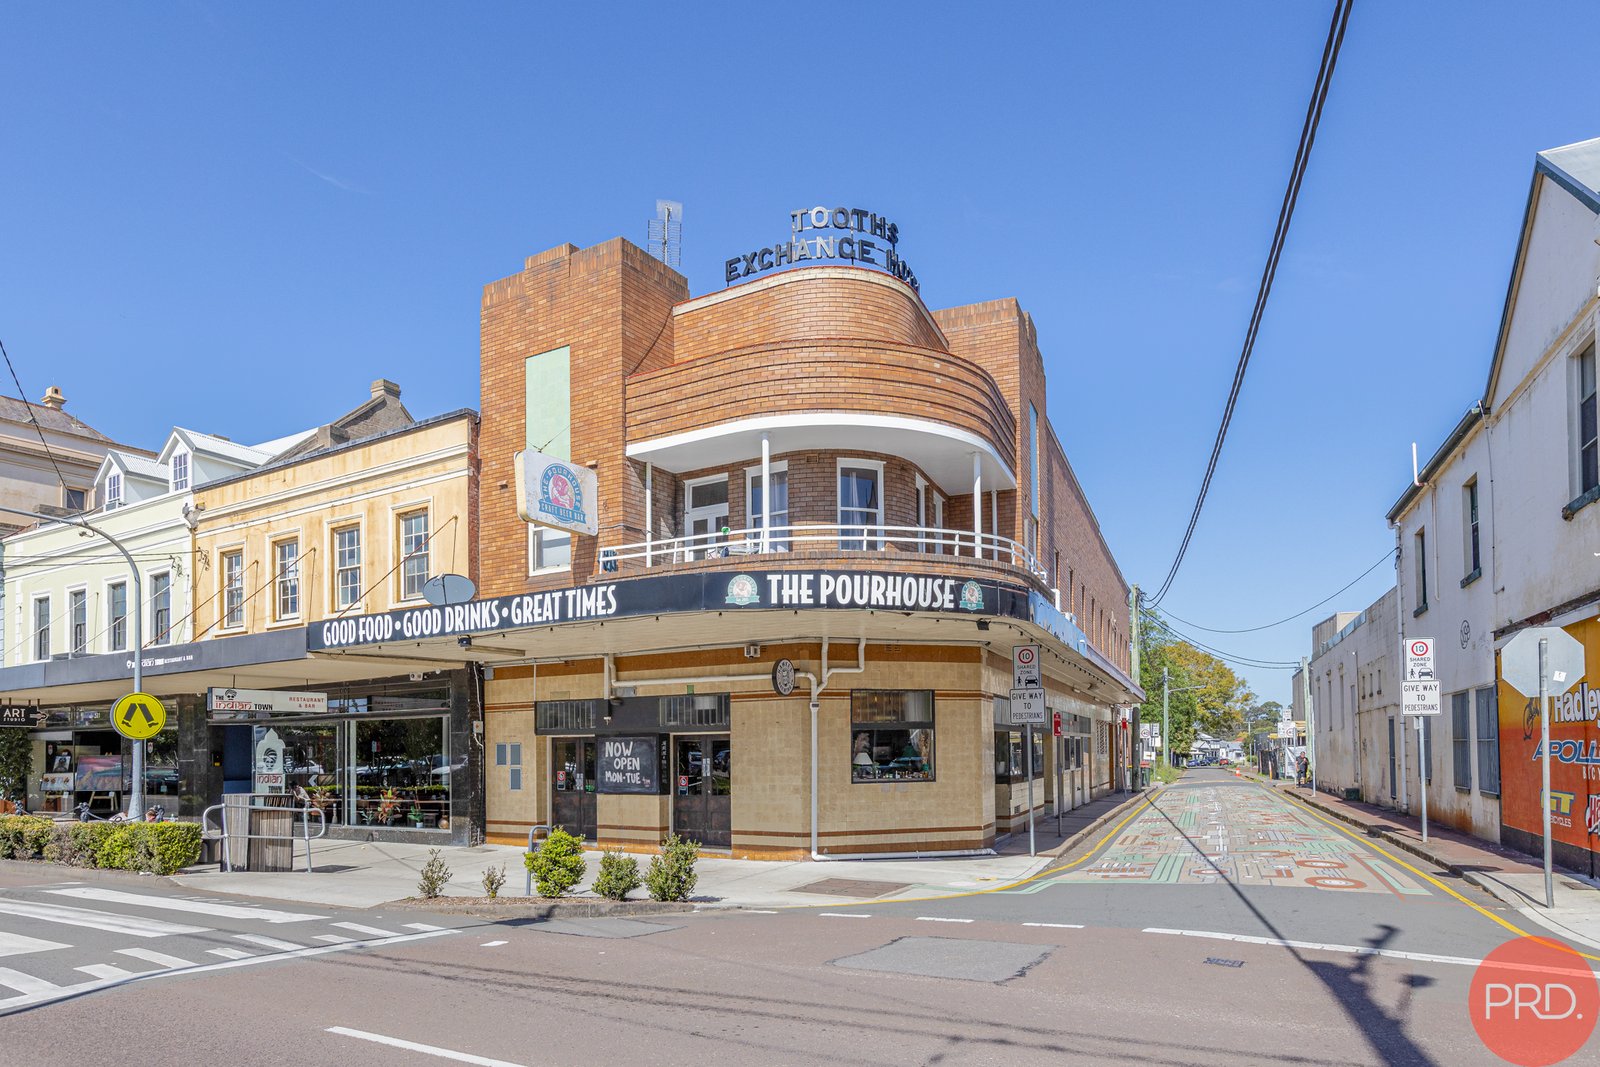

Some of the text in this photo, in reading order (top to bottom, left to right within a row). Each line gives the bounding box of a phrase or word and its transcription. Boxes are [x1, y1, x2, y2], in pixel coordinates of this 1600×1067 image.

[791, 206, 899, 244] TOOTHS
[725, 236, 875, 281] EXCHANGE
[767, 574, 814, 605] THE
[820, 574, 955, 608] POURHOUSE
[323, 586, 617, 646] GOOD FOOD GOOD DRINKS GREAT TIMES
[1404, 684, 1420, 692] GIVE
[3, 708, 26, 718] ART
[605, 741, 633, 757] NOW
[613, 757, 640, 770] OPEN
